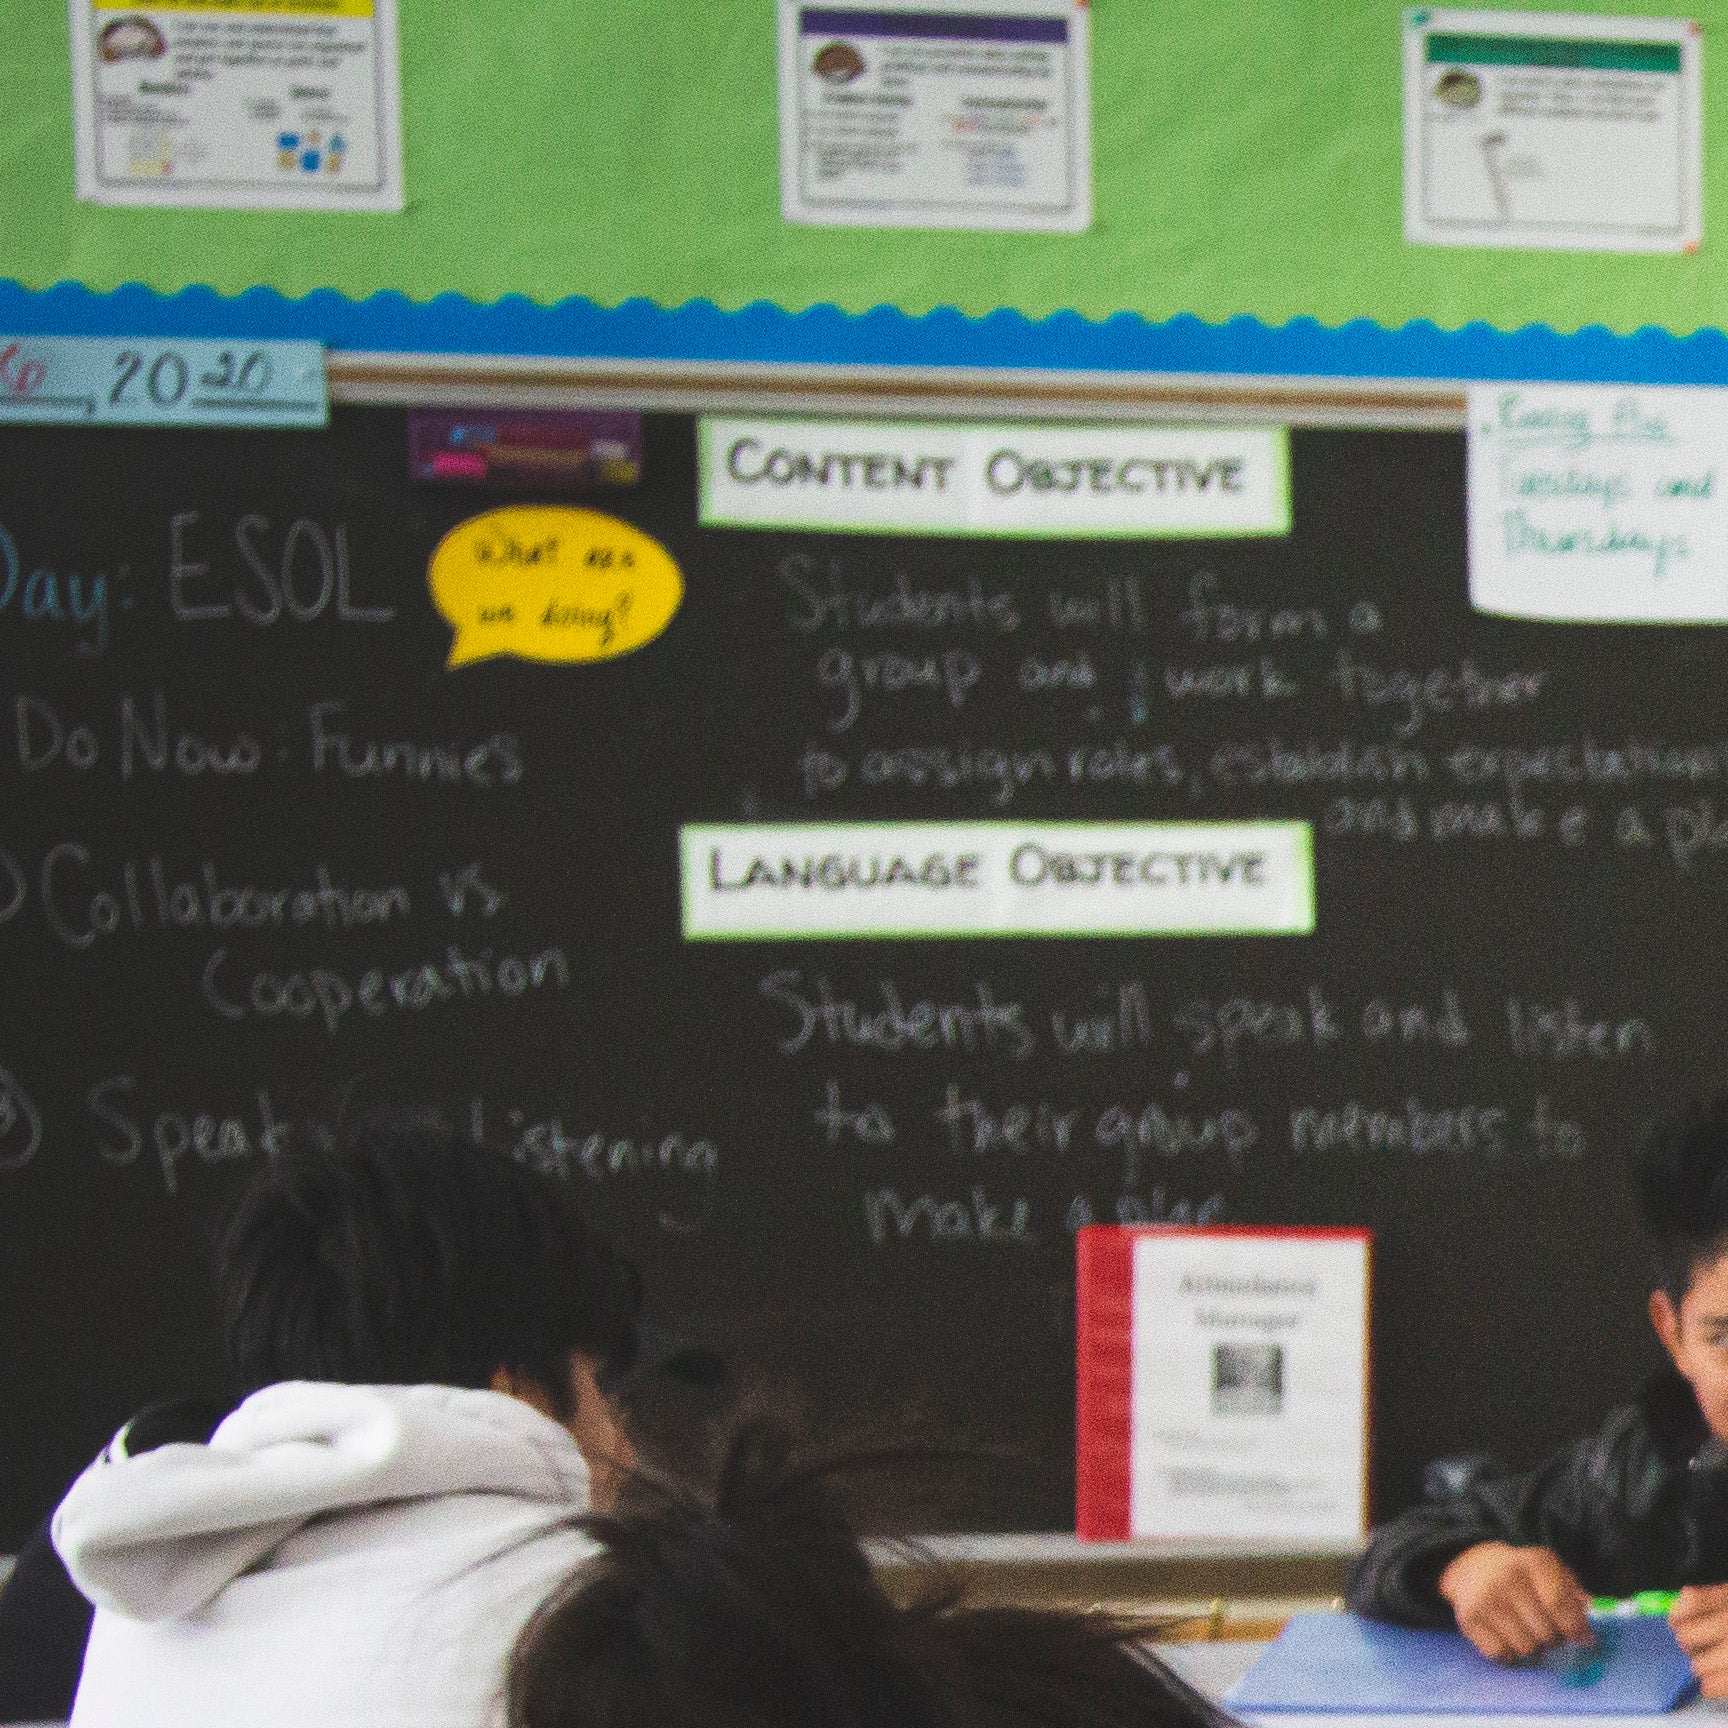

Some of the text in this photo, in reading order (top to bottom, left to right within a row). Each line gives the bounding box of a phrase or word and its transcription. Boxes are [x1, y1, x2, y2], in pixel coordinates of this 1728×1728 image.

[168, 509, 396, 626] ESOL
[1046, 573, 1147, 631] will
[816, 646, 984, 735] group
[1331, 646, 1547, 737] together
[14, 695, 98, 774] Do
[308, 698, 525, 787] Funnies
[42, 840, 411, 949] Collaboration
[201, 944, 570, 1036] Cooperation
[759, 968, 1036, 1063] Students
[1049, 978, 1153, 1057] will
[1174, 984, 1340, 1072] speak
[1361, 988, 1470, 1051] and
[811, 1076, 896, 1143] to
[936, 1080, 1080, 1157] their
[1096, 1101, 1258, 1187] group
